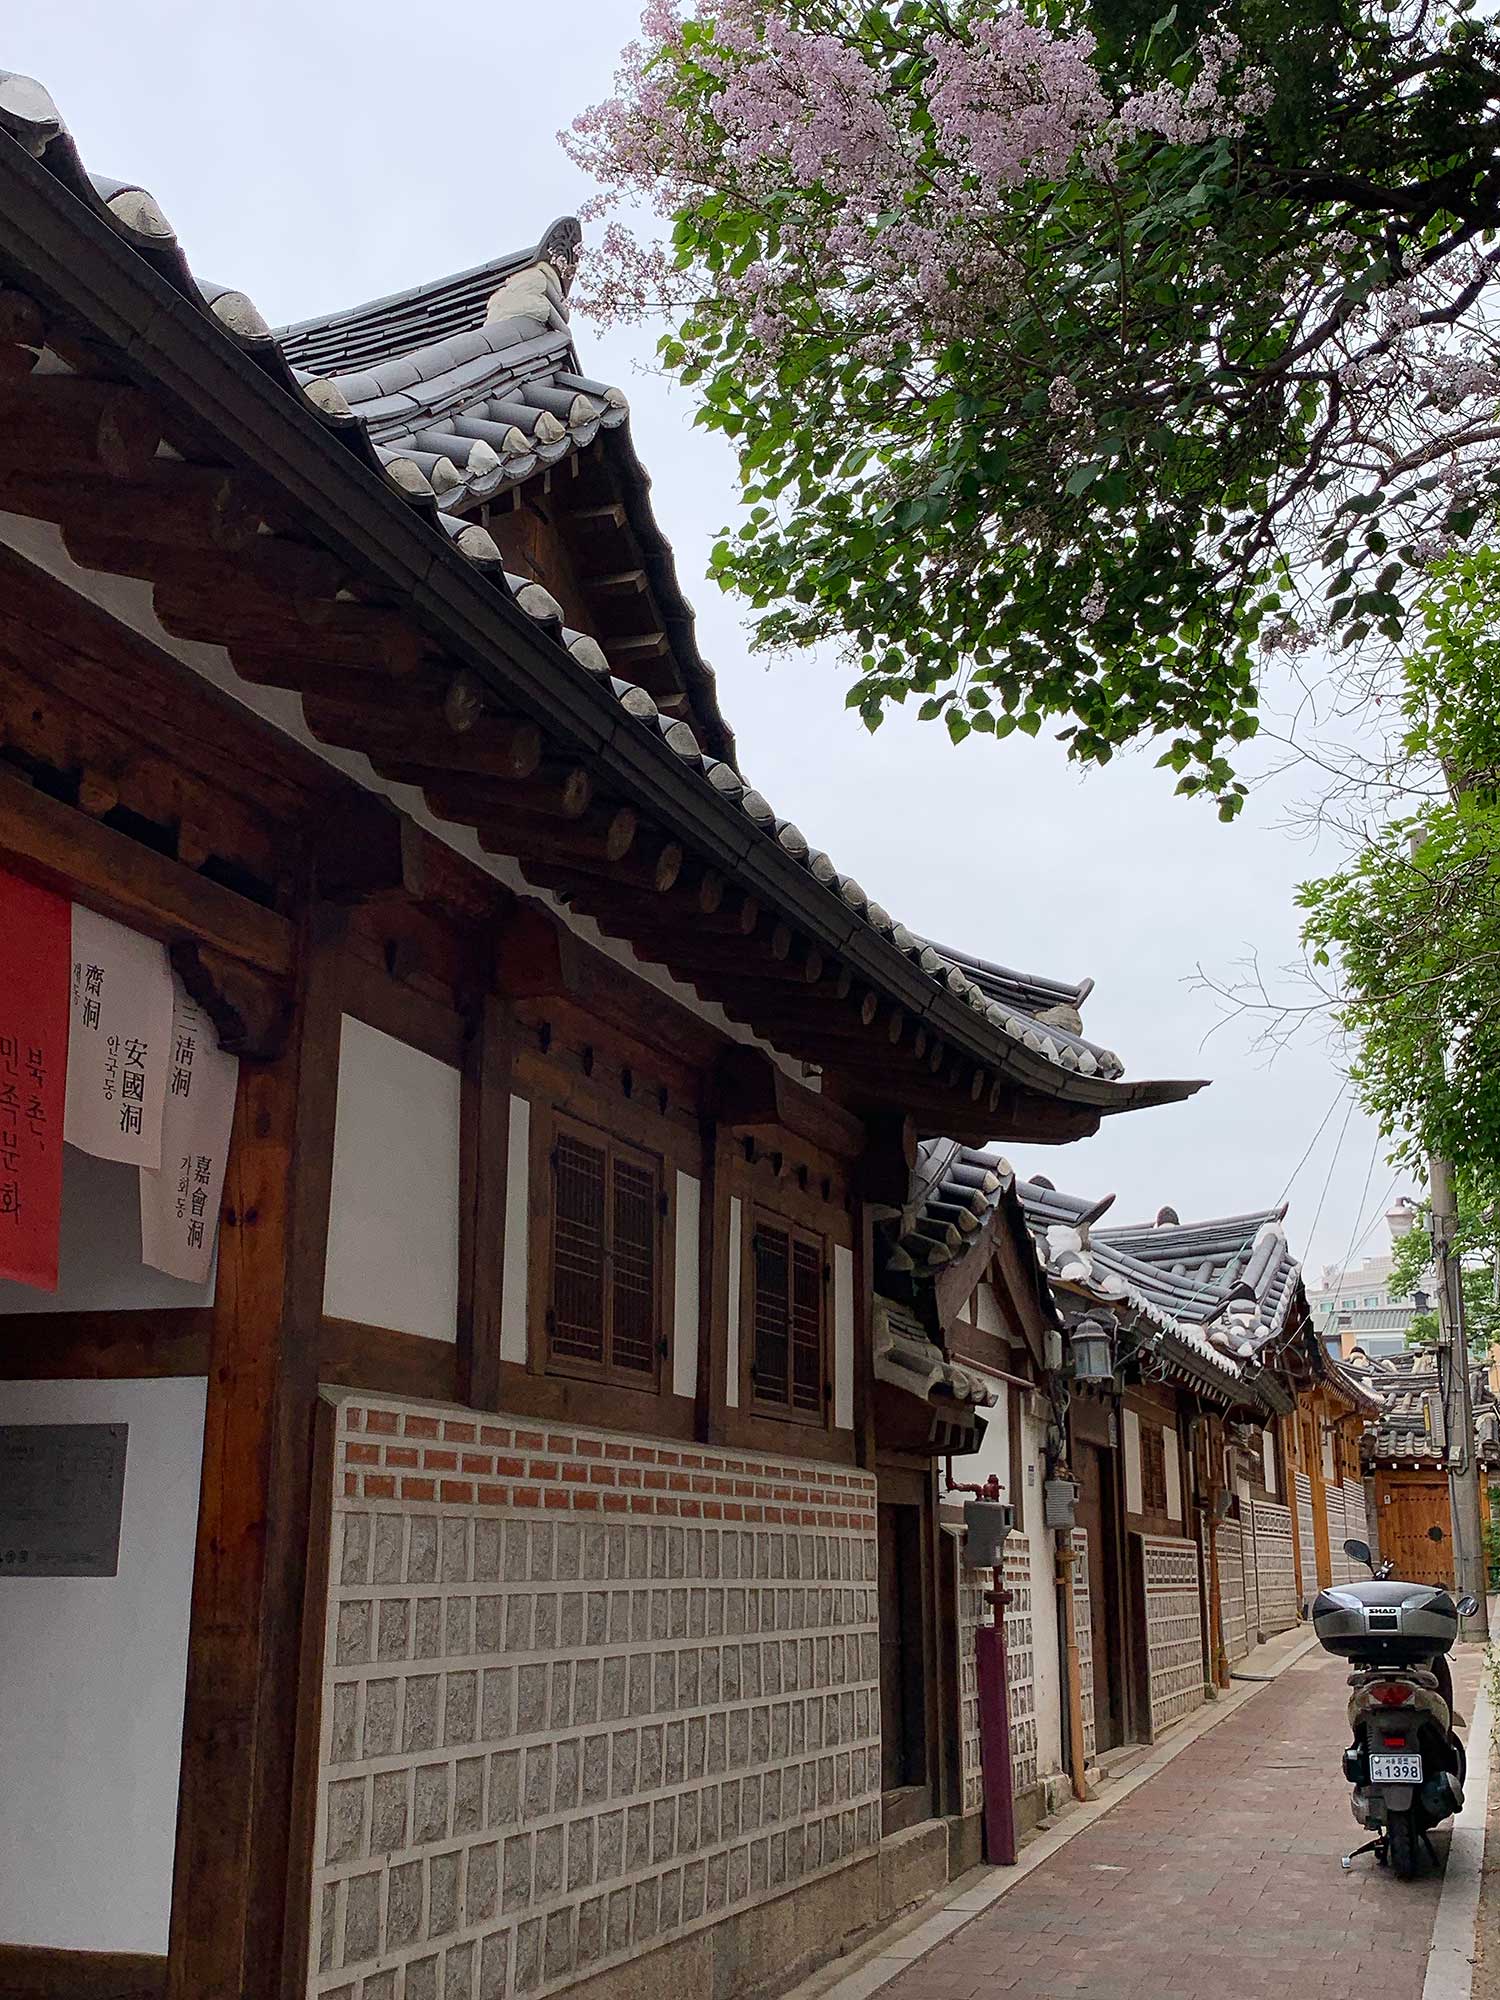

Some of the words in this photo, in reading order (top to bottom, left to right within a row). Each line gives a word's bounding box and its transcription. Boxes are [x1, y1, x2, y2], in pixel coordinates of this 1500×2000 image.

[103, 1035, 121, 1100] 안국동
[120, 1038, 147, 1135] 安國洞
[176, 1156, 192, 1218] 가회동
[187, 1156, 212, 1250] 嘉會洞
[1385, 1765, 1418, 1778] 1398
